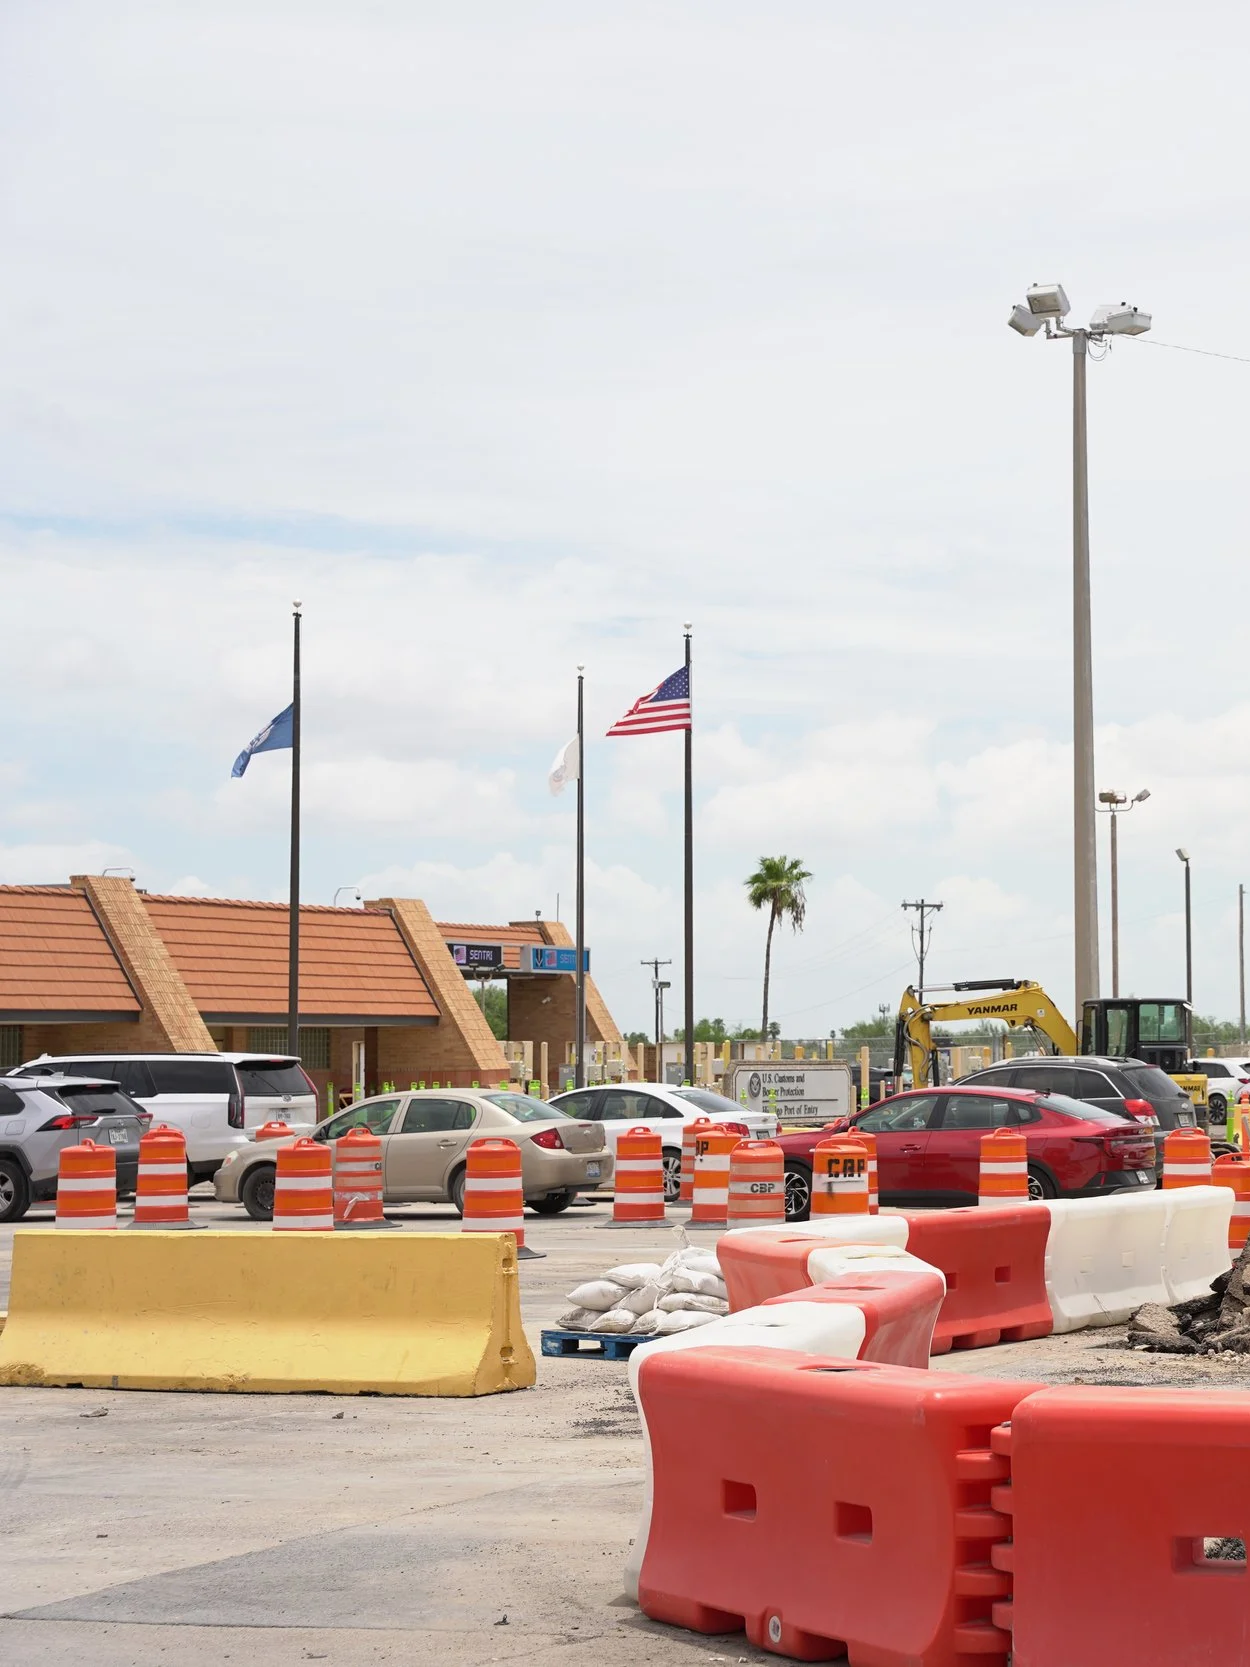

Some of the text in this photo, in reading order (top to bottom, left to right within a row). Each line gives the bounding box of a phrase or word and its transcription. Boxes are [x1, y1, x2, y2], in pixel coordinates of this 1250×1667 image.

[469, 949, 493, 961] SENTRI
[559, 953, 577, 964] SENT
[967, 1003, 1018, 1015] YANMAR
[762, 1073, 805, 1083] U.S. Customs and
[780, 1086, 804, 1096] Protection
[784, 1105, 795, 1115] Port
[796, 1105, 802, 1114] of
[804, 1104, 818, 1116] Entry
[750, 1183, 775, 1193] CBP
